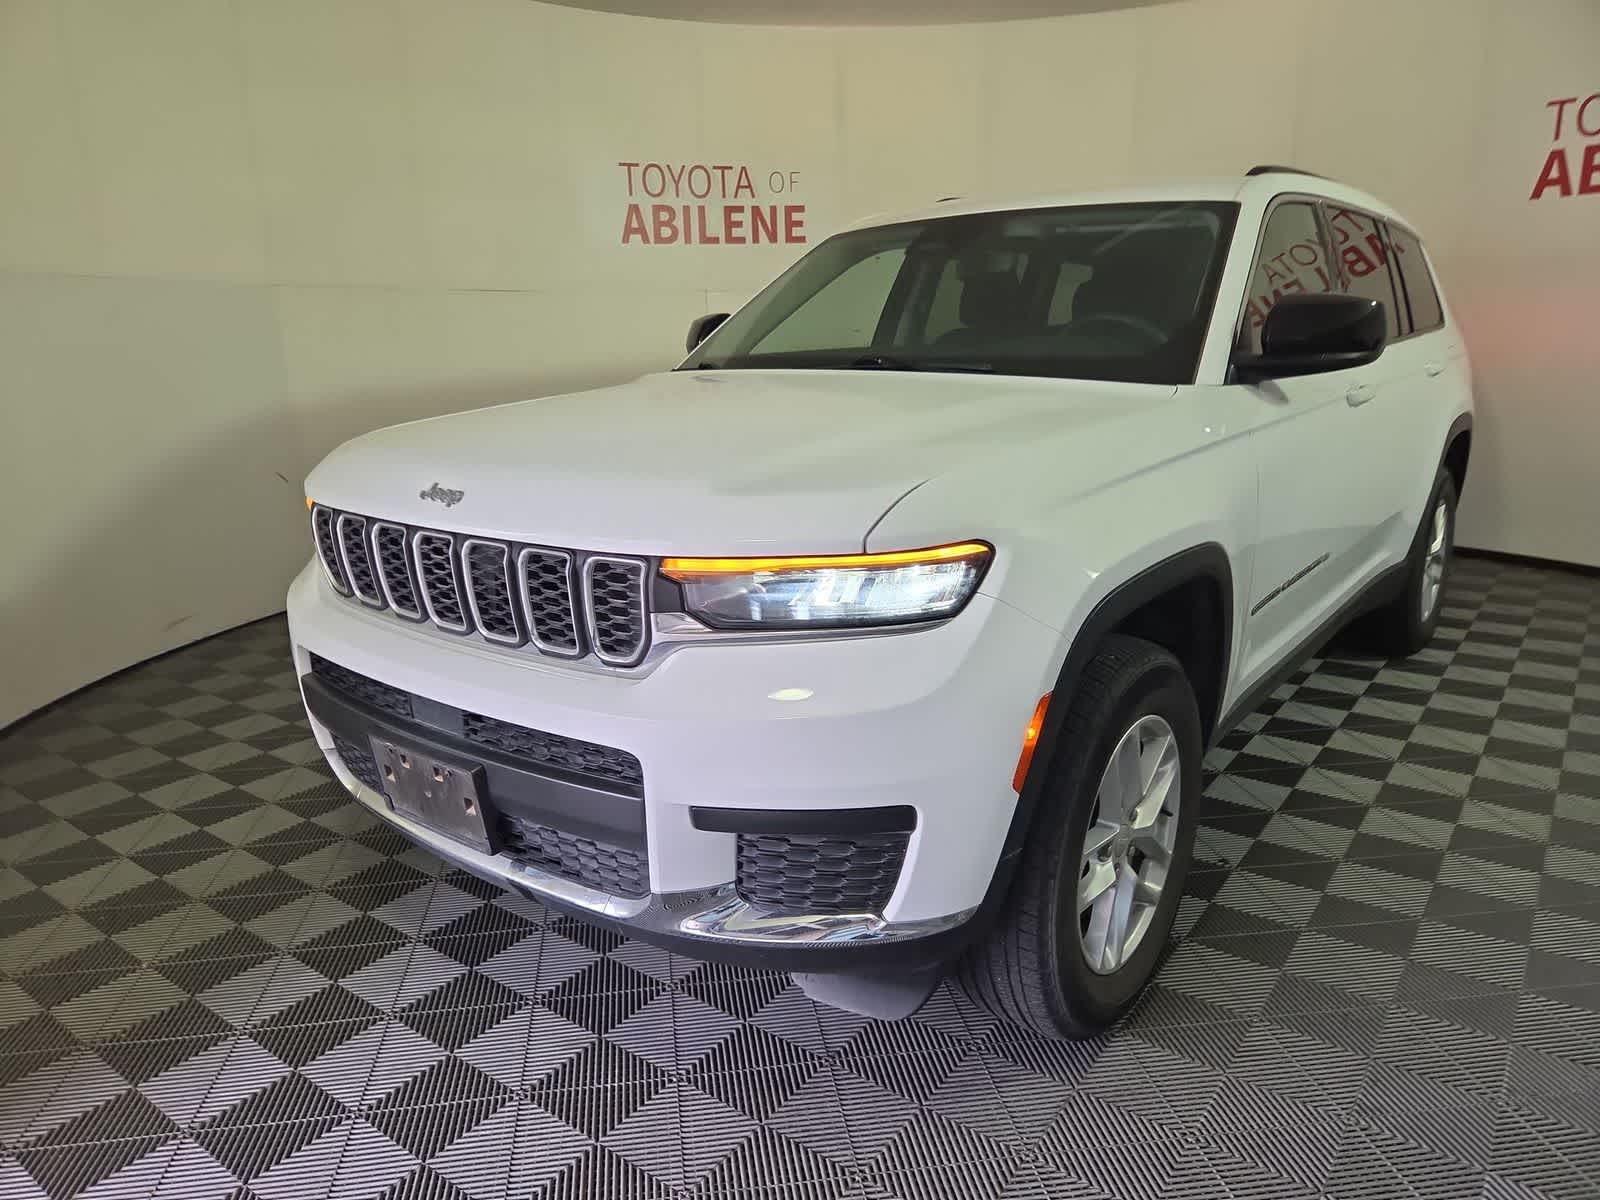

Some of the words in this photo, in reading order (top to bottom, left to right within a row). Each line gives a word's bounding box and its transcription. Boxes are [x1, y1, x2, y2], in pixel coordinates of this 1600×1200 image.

[618, 162, 756, 199] TOYOTA
[768, 171, 801, 194] OF
[621, 203, 807, 245] ABILENE
